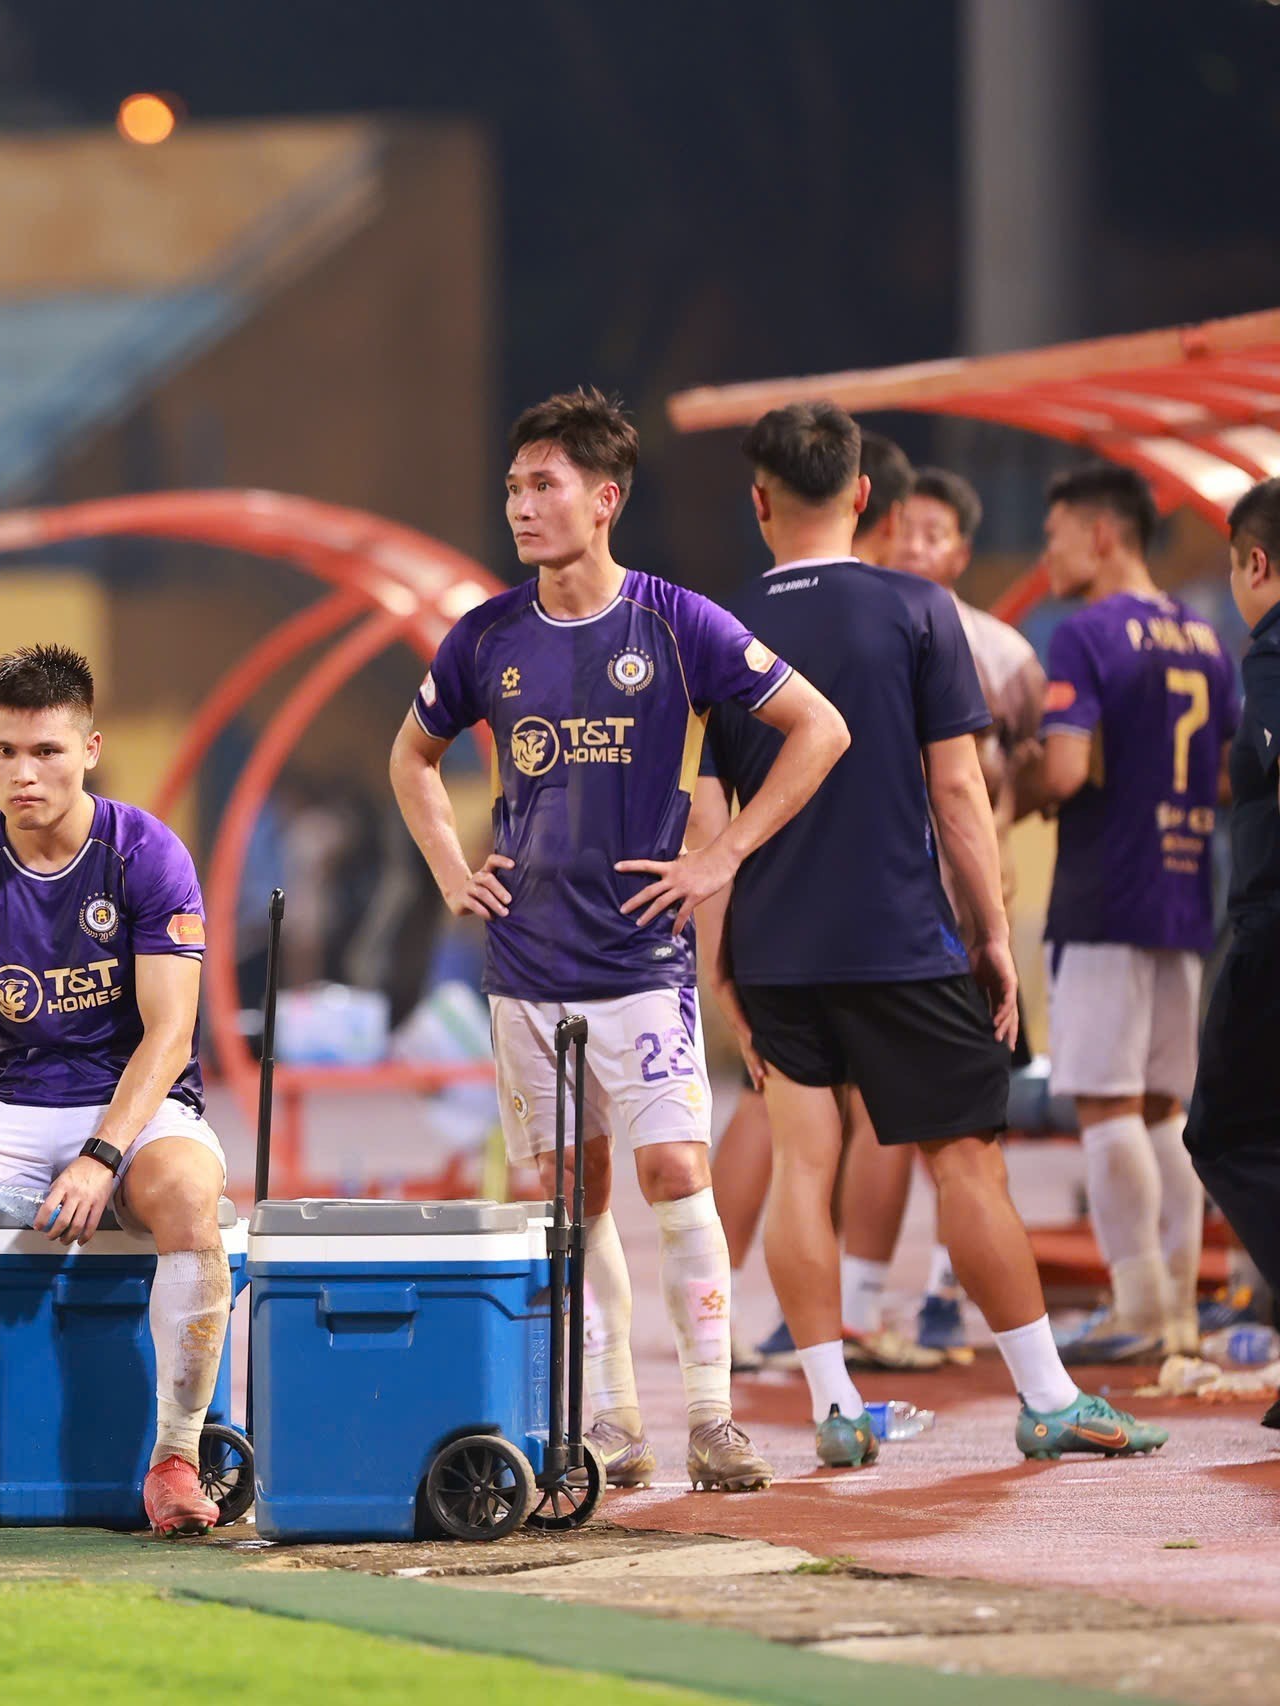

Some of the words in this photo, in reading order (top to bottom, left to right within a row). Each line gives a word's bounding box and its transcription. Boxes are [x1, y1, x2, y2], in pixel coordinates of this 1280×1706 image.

[560, 716, 635, 747] T&T
[1165, 667, 1210, 794] 7
[563, 747, 632, 765] HOMES
[44, 958, 119, 997] T&T
[47, 985, 122, 1015] HOMES
